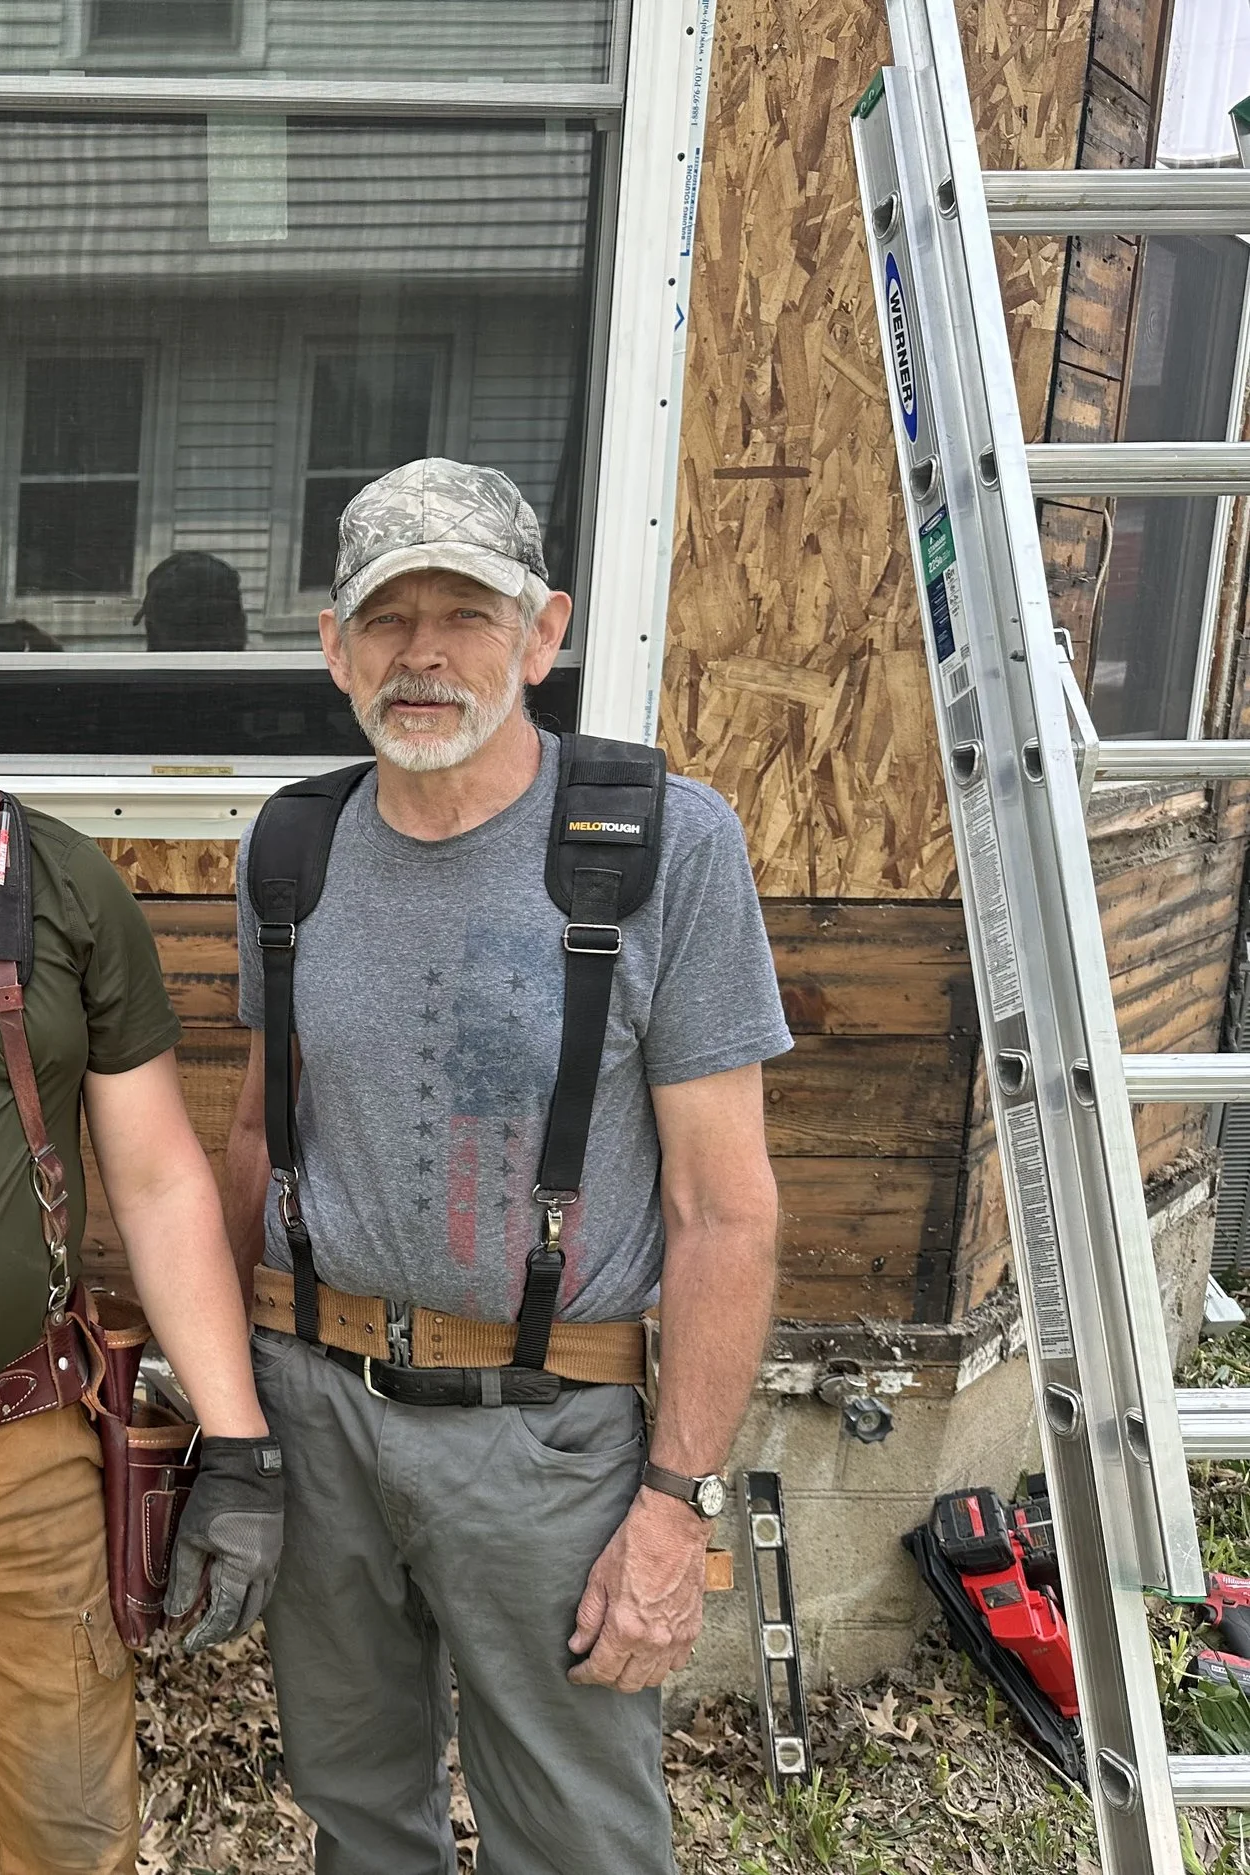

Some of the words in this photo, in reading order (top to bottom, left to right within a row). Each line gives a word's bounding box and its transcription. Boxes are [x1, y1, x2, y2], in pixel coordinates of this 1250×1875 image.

[690, 65, 702, 126] 1-888-976-POLY
[683, 164, 693, 205] SOLUTIONS
[890, 290, 913, 404] WERNER
[569, 821, 641, 834] MELOTOUGH
